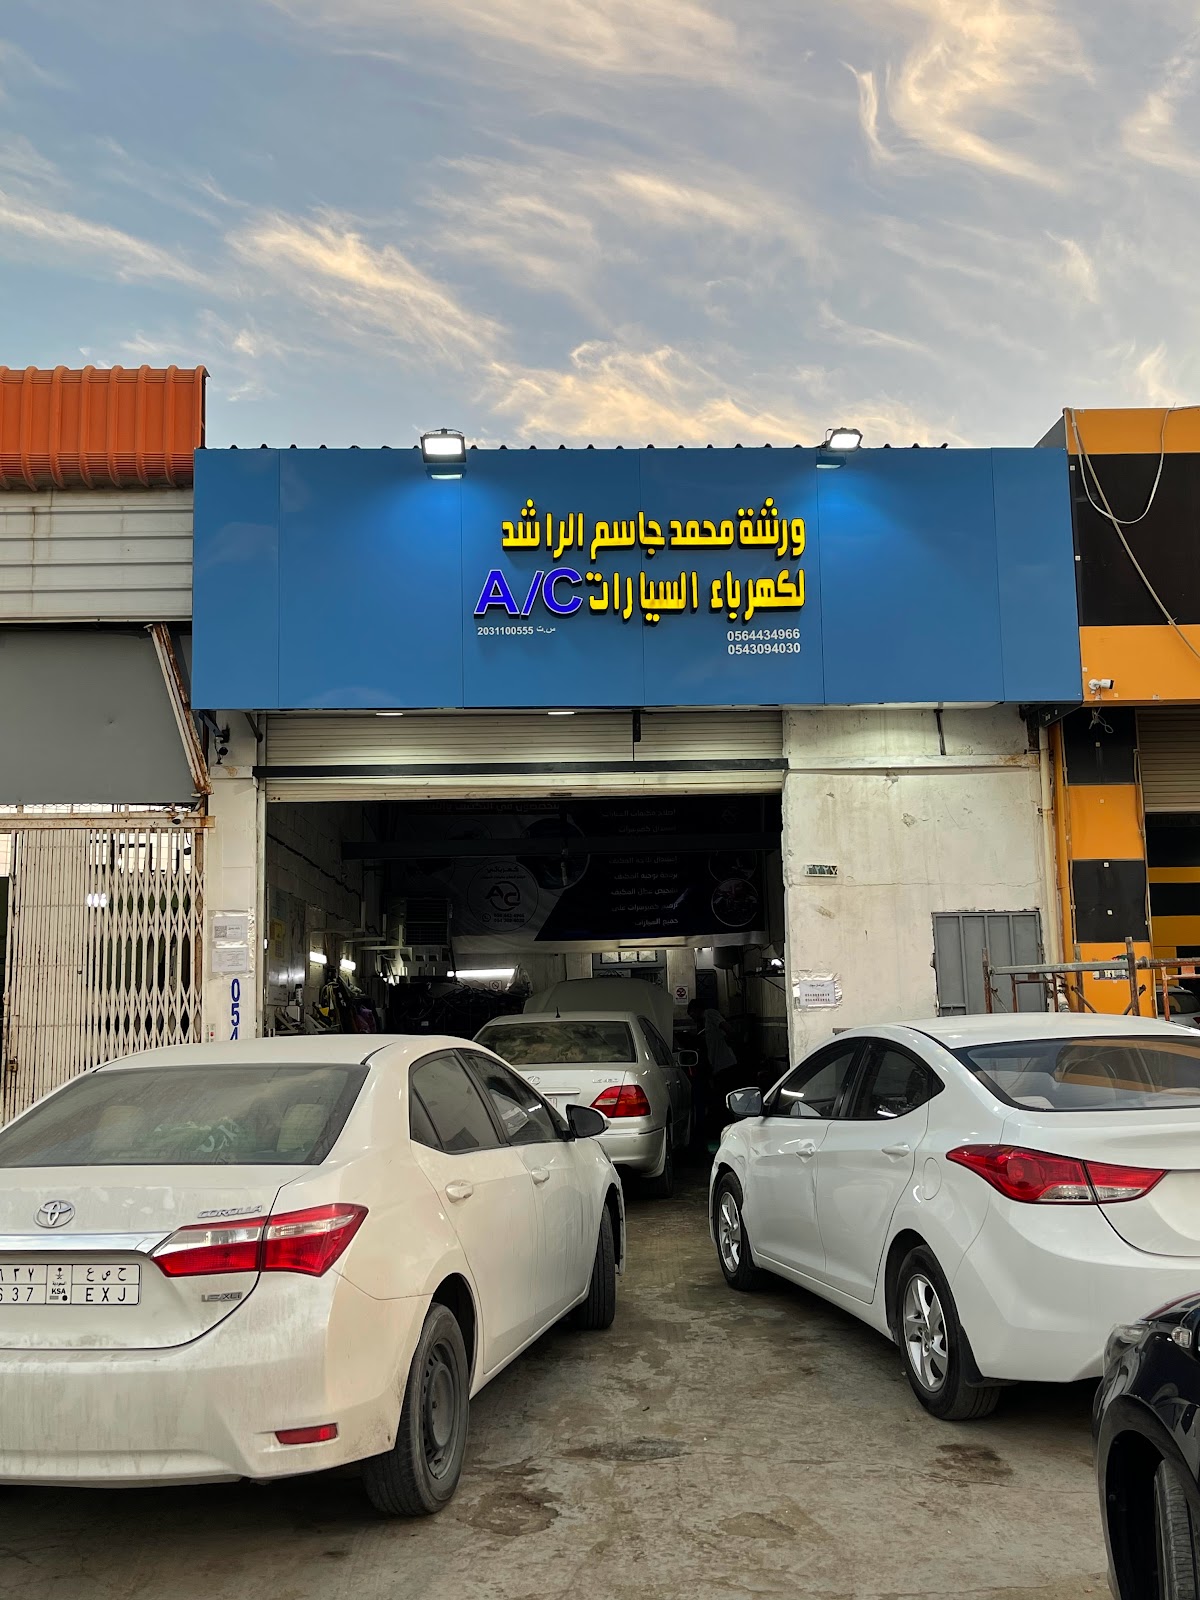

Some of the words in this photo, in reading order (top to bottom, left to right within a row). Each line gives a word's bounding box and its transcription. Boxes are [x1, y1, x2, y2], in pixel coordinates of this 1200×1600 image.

[502, 499, 584, 559] الراشد
[591, 511, 665, 560] جاسم
[670, 519, 735, 546] محمد
[739, 498, 806, 556] ورشة
[473, 567, 584, 616] A/C
[585, 570, 698, 622] السيارات
[711, 569, 805, 620] لكهرباء
[477, 626, 534, 636] 2031100555
[727, 628, 800, 642] 0564434966
[727, 642, 801, 655] 0543094030
[197, 1205, 263, 1219] COROLLA
